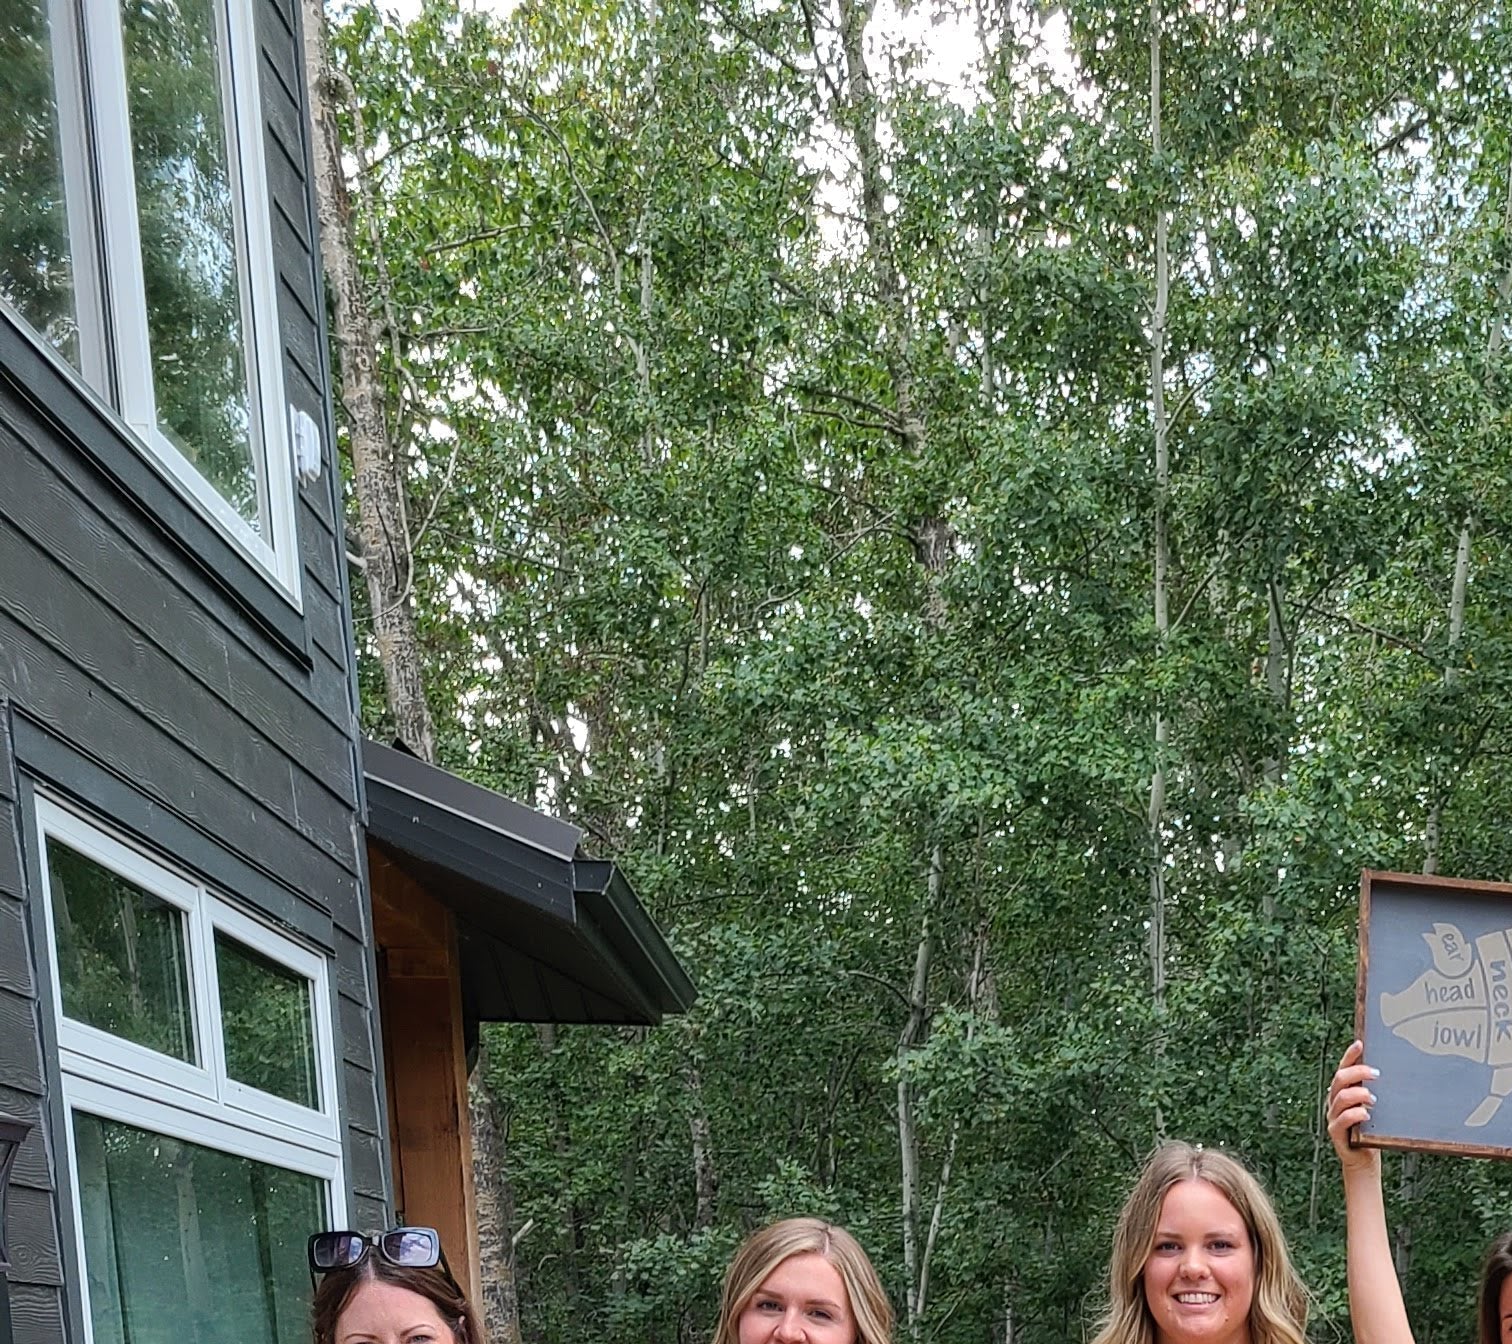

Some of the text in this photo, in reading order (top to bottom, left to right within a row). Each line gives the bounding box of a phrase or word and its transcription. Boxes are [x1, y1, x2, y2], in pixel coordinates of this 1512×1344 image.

[1442, 932, 1465, 962] ear
[1424, 978, 1475, 1003] head
[1488, 958, 1512, 1041] neck
[1430, 1021, 1482, 1050] jowl
